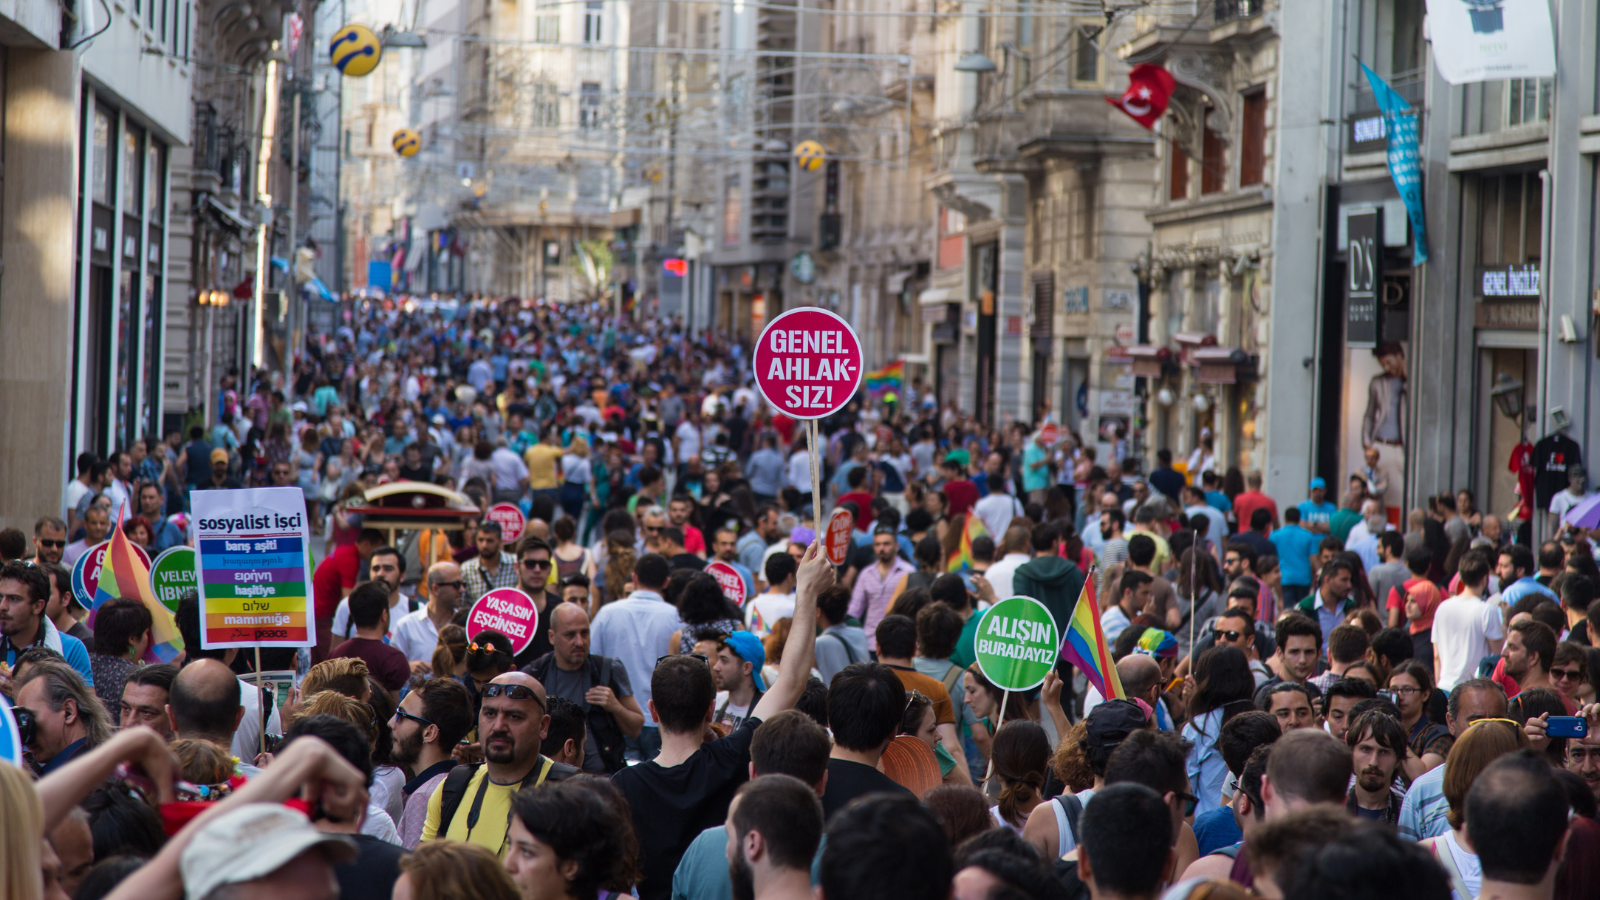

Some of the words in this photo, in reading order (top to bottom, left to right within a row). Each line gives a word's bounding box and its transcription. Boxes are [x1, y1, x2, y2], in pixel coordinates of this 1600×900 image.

[1350, 236, 1374, 291] D'S
[1483, 271, 1508, 296] GENEL
[770, 329, 849, 354] GENEL
[767, 357, 857, 381] AHLAK-
[785, 385, 833, 409] SIZ!
[199, 514, 271, 534] sosyalist
[274, 512, 302, 531] işçi
[225, 540, 251, 553] barış
[254, 539, 277, 553] aşiti
[160, 570, 197, 582] VELEV
[234, 569, 272, 583] ειρήνη
[234, 585, 276, 598] haşitiye
[243, 600, 270, 611] שלום
[486, 595, 533, 621] YAŞASIN
[224, 613, 290, 626] mamırnığe
[473, 610, 527, 638] EŞCİNSEL
[987, 615, 1051, 645] ALIŞIN
[254, 629, 288, 640] peace
[978, 639, 1054, 665] BURADAYIZ
